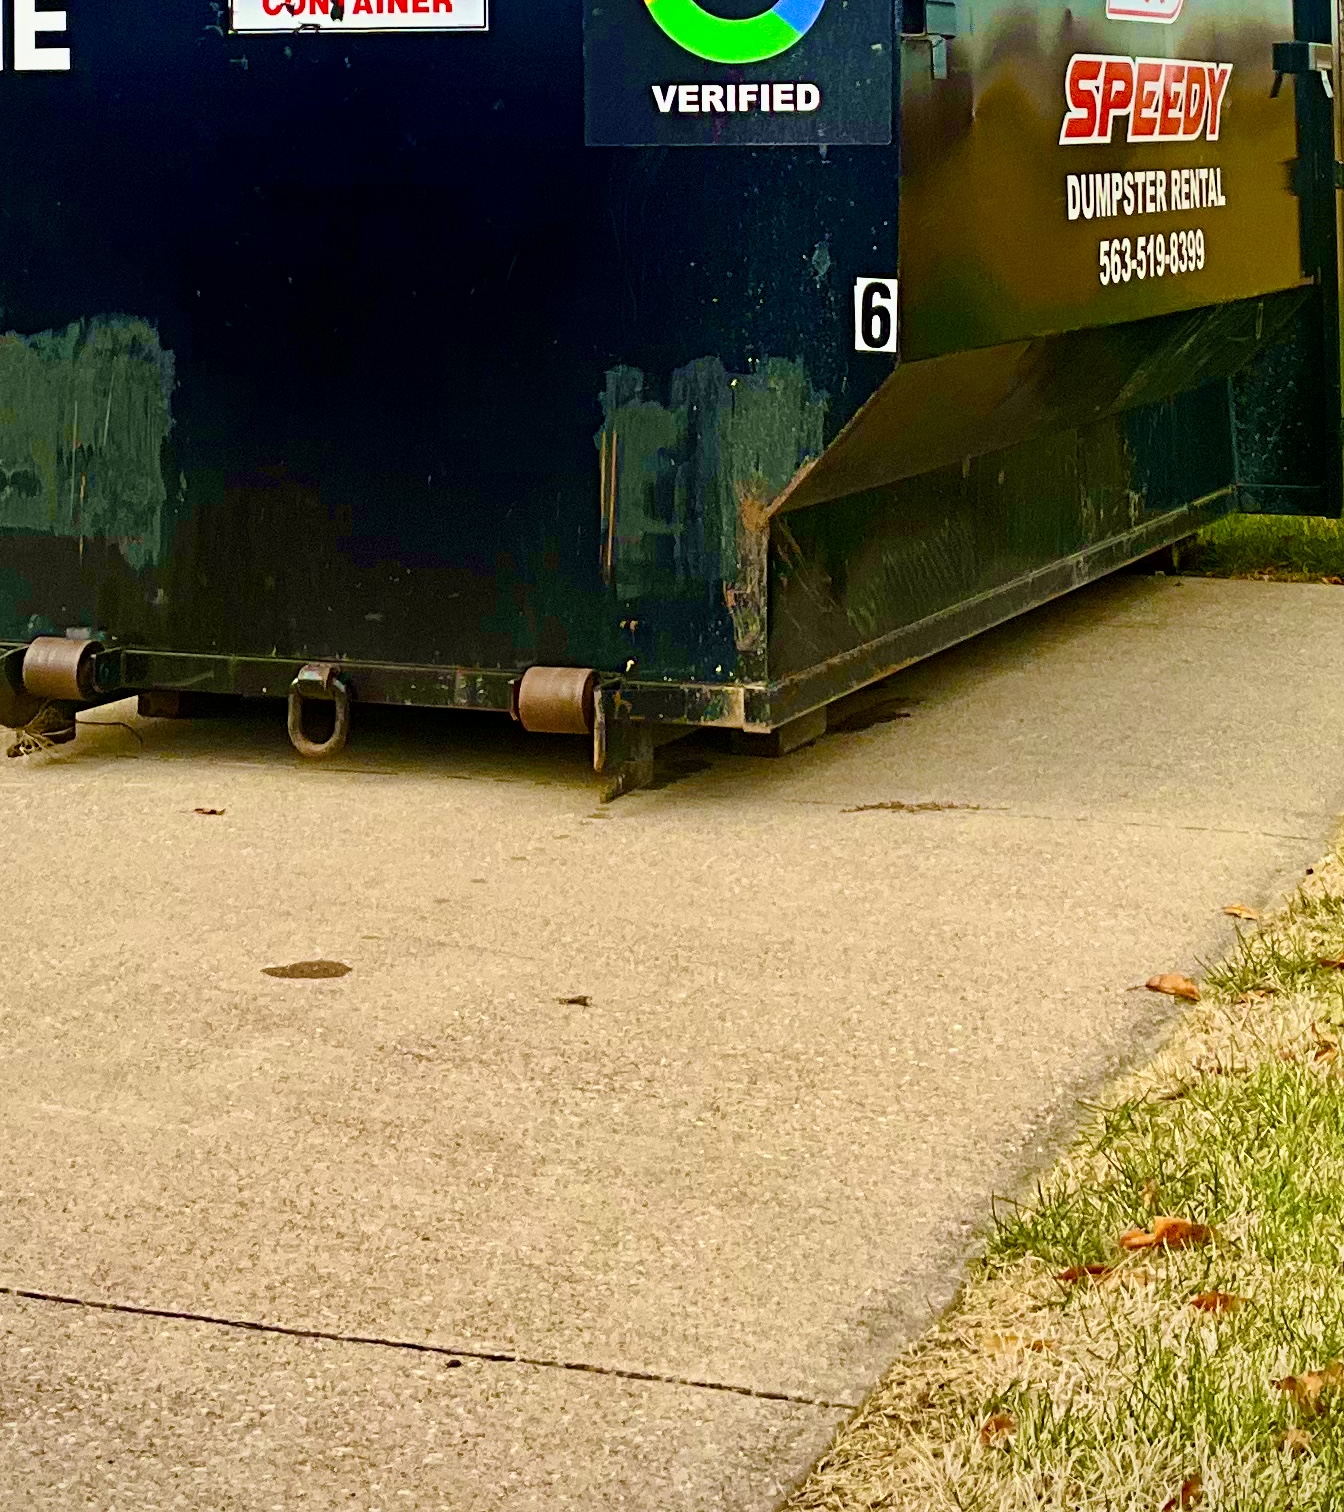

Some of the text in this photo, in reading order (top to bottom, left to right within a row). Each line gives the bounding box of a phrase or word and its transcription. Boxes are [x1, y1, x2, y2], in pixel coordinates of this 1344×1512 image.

[651, 83, 820, 114] VERIFIED
[1058, 53, 1234, 146] SPEEDY
[1066, 167, 1226, 221] DUMPSTER RENTAL
[1098, 228, 1205, 286] 563-519-8399
[860, 281, 892, 349] 6
